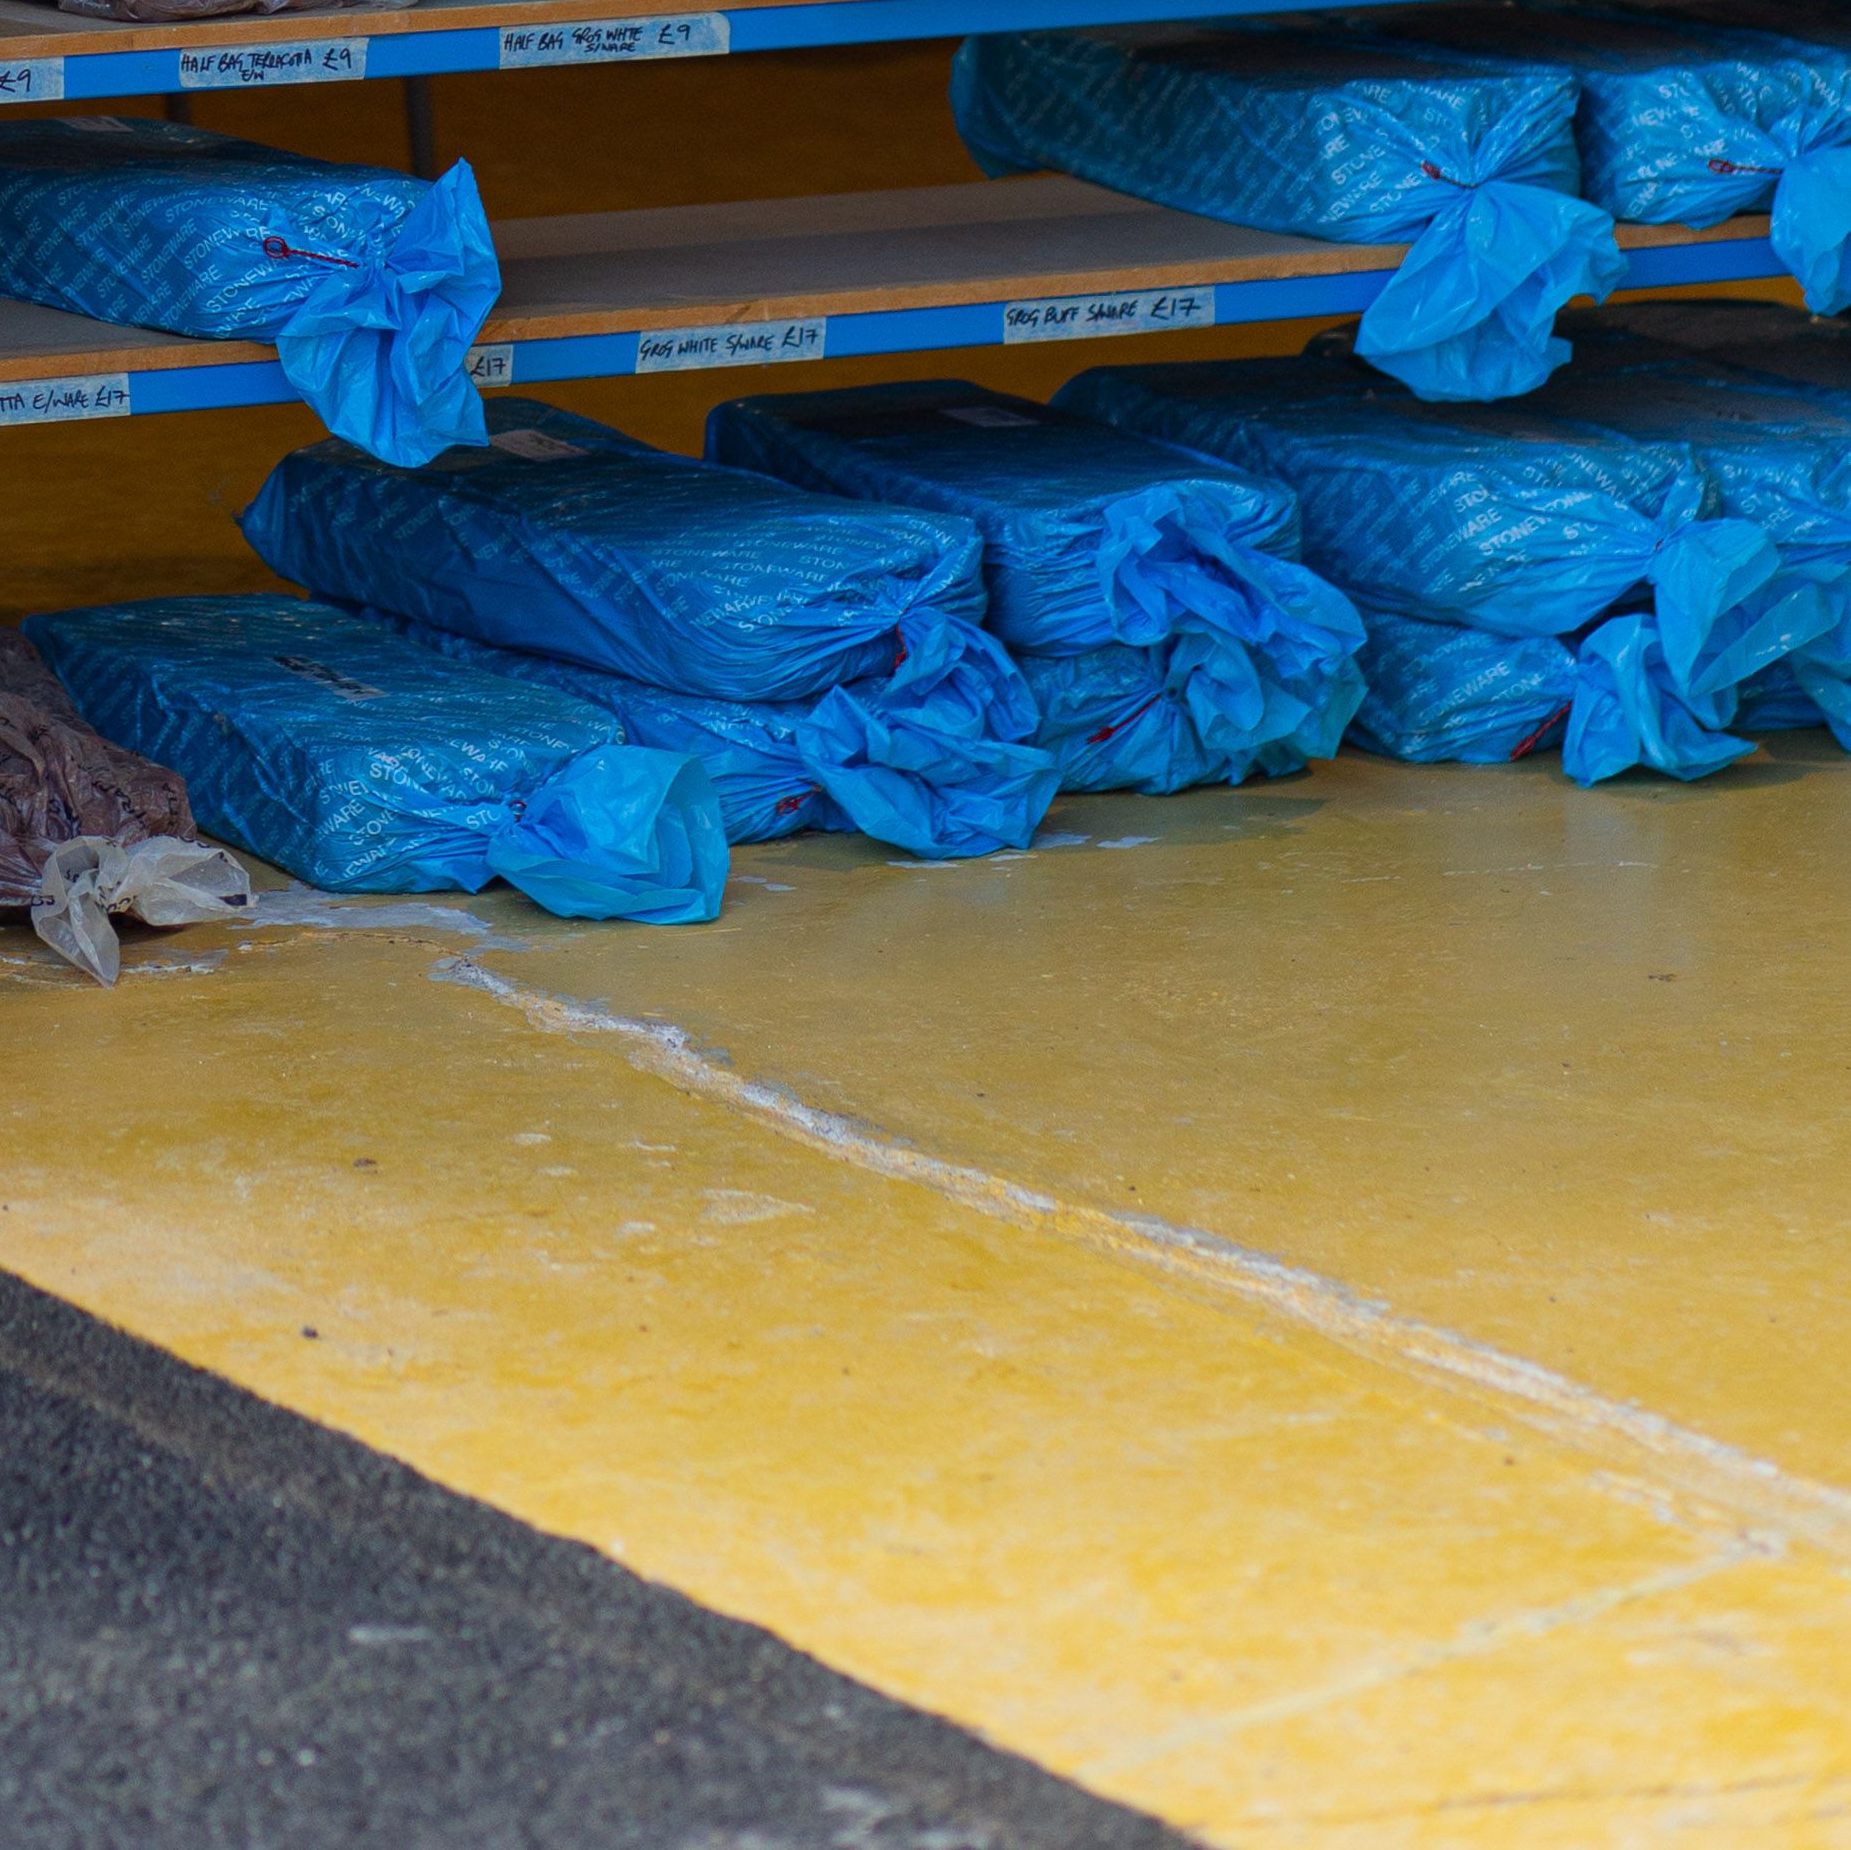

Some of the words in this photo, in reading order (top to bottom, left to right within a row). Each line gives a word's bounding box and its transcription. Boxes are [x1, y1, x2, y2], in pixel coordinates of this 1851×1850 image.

[504, 33, 535, 52] HALF
[538, 32, 563, 50] BAG
[658, 24, 690, 45] £9
[181, 53, 216, 73] HALF
[218, 52, 244, 73] BAG
[323, 47, 351, 71] £9
[74, 189, 140, 251] STONEWARE
[141, 217, 197, 286] STONEWARE
[183, 225, 272, 271] STONEWRE
[98, 232, 153, 298] STONEWARE
[159, 262, 223, 329] STONEWARE
[1006, 307, 1040, 327] GROG
[1044, 306, 1080, 325] BUFF
[1150, 296, 1201, 320] £17
[640, 339, 673, 361] GROG
[677, 337, 718, 355] WHITE
[781, 326, 819, 347] £17
[471, 356, 506, 377] £17
[32, 390, 89, 414] E/WARE
[95, 386, 130, 407] £17
[720, 561, 830, 583] STONEWARE
